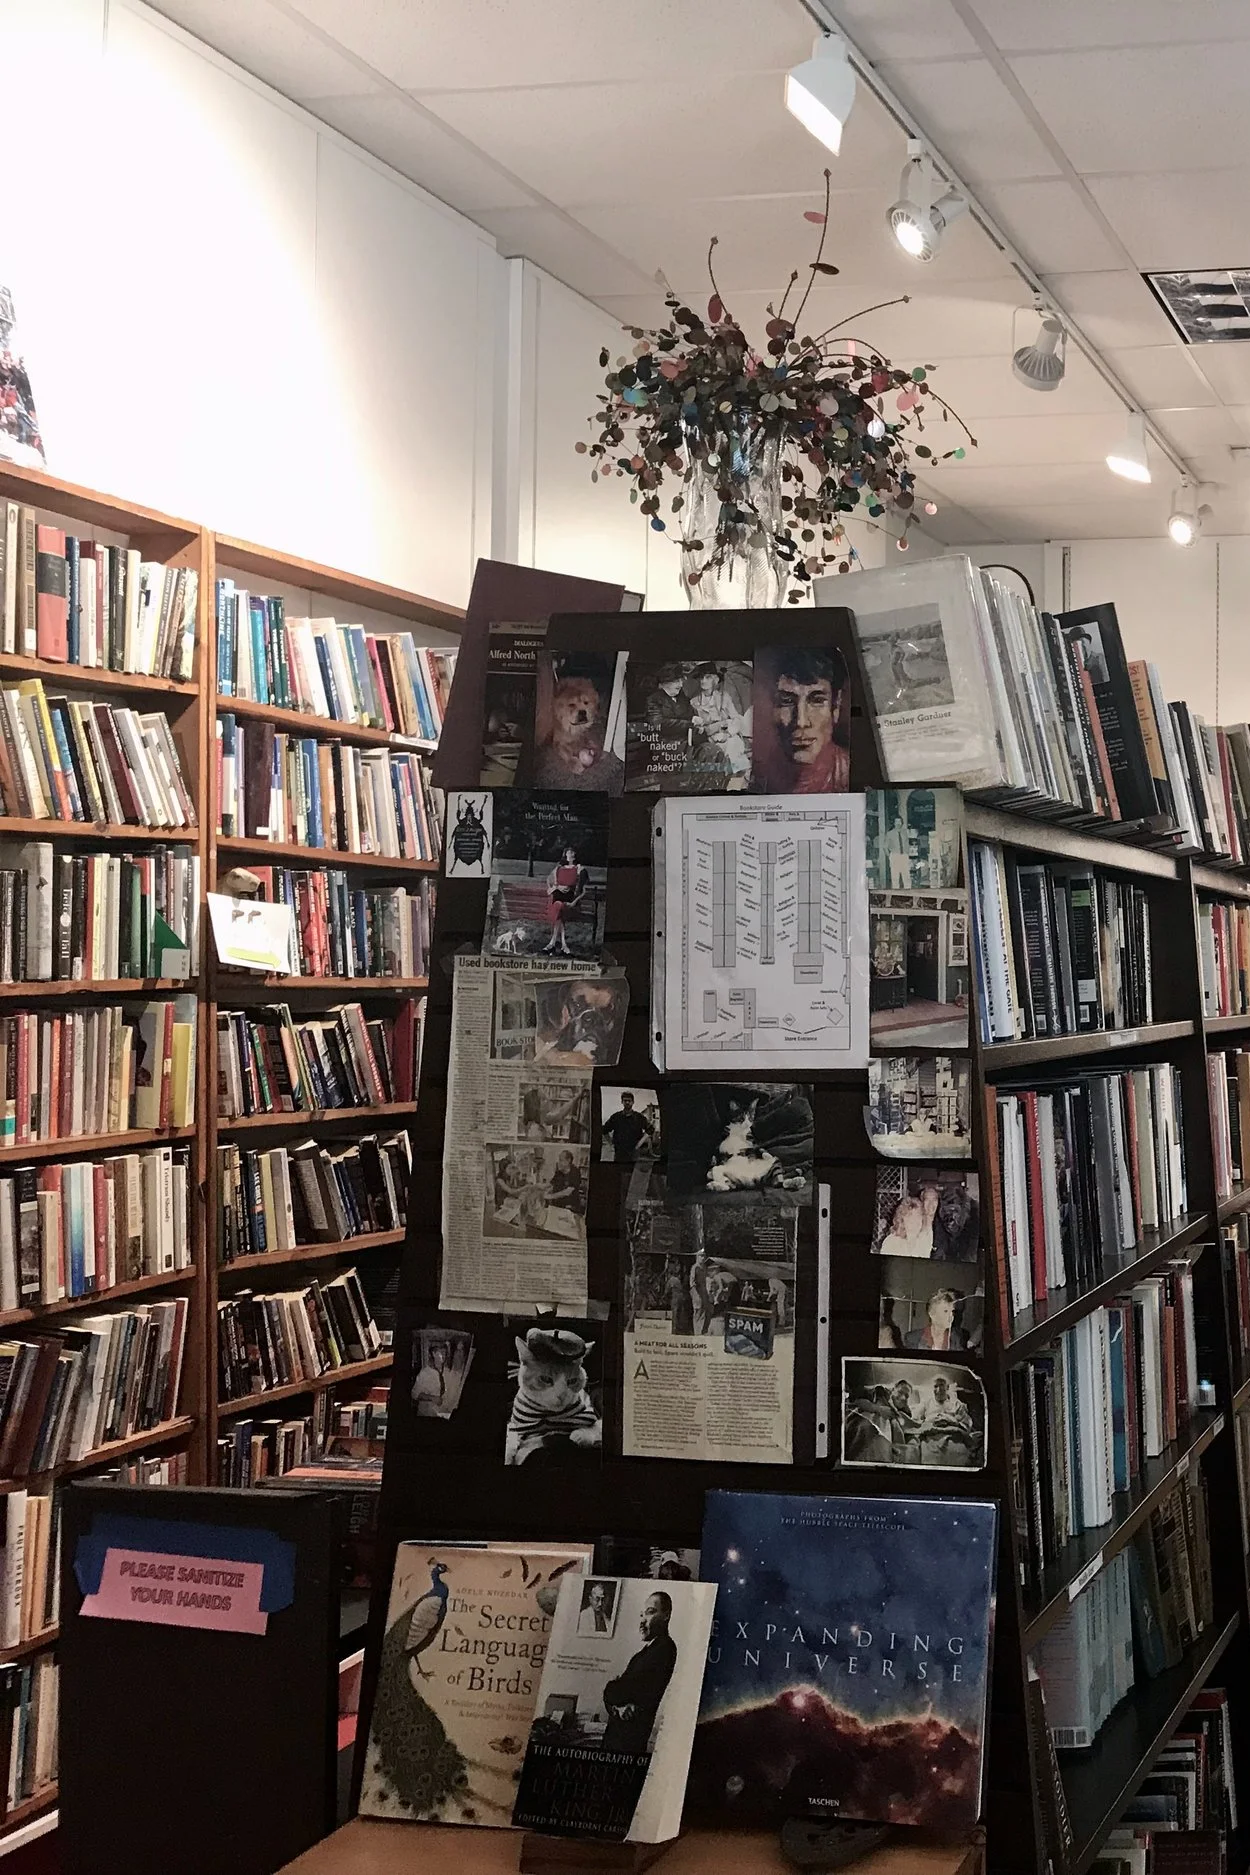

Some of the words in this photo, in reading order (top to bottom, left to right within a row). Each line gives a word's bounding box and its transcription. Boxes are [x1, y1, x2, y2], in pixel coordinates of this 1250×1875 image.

[488, 650, 512, 660] Alfred
[513, 650, 536, 661] North
[884, 717, 915, 728] Stanley
[917, 710, 952, 722] Gardner
[637, 732, 660, 743] "butt
[650, 740, 681, 751] naked"
[661, 752, 688, 762] "buck
[532, 802, 558, 811] Waiting
[525, 812, 536, 820] the
[538, 812, 561, 821] Perfect
[459, 957, 481, 968] Used
[483, 957, 529, 969] bookstore
[531, 959, 549, 970] has
[550, 961, 568, 971] new
[570, 959, 597, 972] home
[496, 1037, 519, 1047] BOOK
[728, 1318, 764, 1334] SPAM
[634, 1359, 650, 1380] A
[781, 1517, 796, 1525] THE
[799, 1519, 831, 1527] HUBBLE
[833, 1521, 859, 1529] SPACE
[861, 1523, 906, 1532] TELESCOPE
[800, 1510, 862, 1521] PHOTOGRAPHS
[863, 1515, 887, 1523] FROM
[120, 1560, 174, 1581] PLEASE
[176, 1566, 244, 1589] SANITIZE
[130, 1585, 172, 1606] YOUR
[176, 1590, 232, 1612] HANDS
[456, 1588, 484, 1596] ADELE
[487, 1589, 529, 1599] NOZEDAR
[450, 1598, 477, 1613] The
[478, 1605, 551, 1633] Secret
[710, 1620, 964, 1656] EXPANDING
[439, 1628, 548, 1669] Languag
[707, 1647, 963, 1682] UNIVERSE
[446, 1670, 464, 1686] of
[467, 1667, 533, 1696] Birds
[534, 1744, 552, 1756] THE
[556, 1747, 635, 1766] AUTOBIOGRAPHY
[636, 1756, 649, 1766] OF
[554, 1761, 636, 1784] MARTIN
[532, 1778, 614, 1800] LUTHER
[550, 1799, 601, 1820] KING
[807, 1795, 841, 1808] TASCHEN
[518, 1813, 546, 1825] EDITED
[548, 1817, 558, 1826] BY
[560, 1819, 602, 1832] CLAYBORNE
